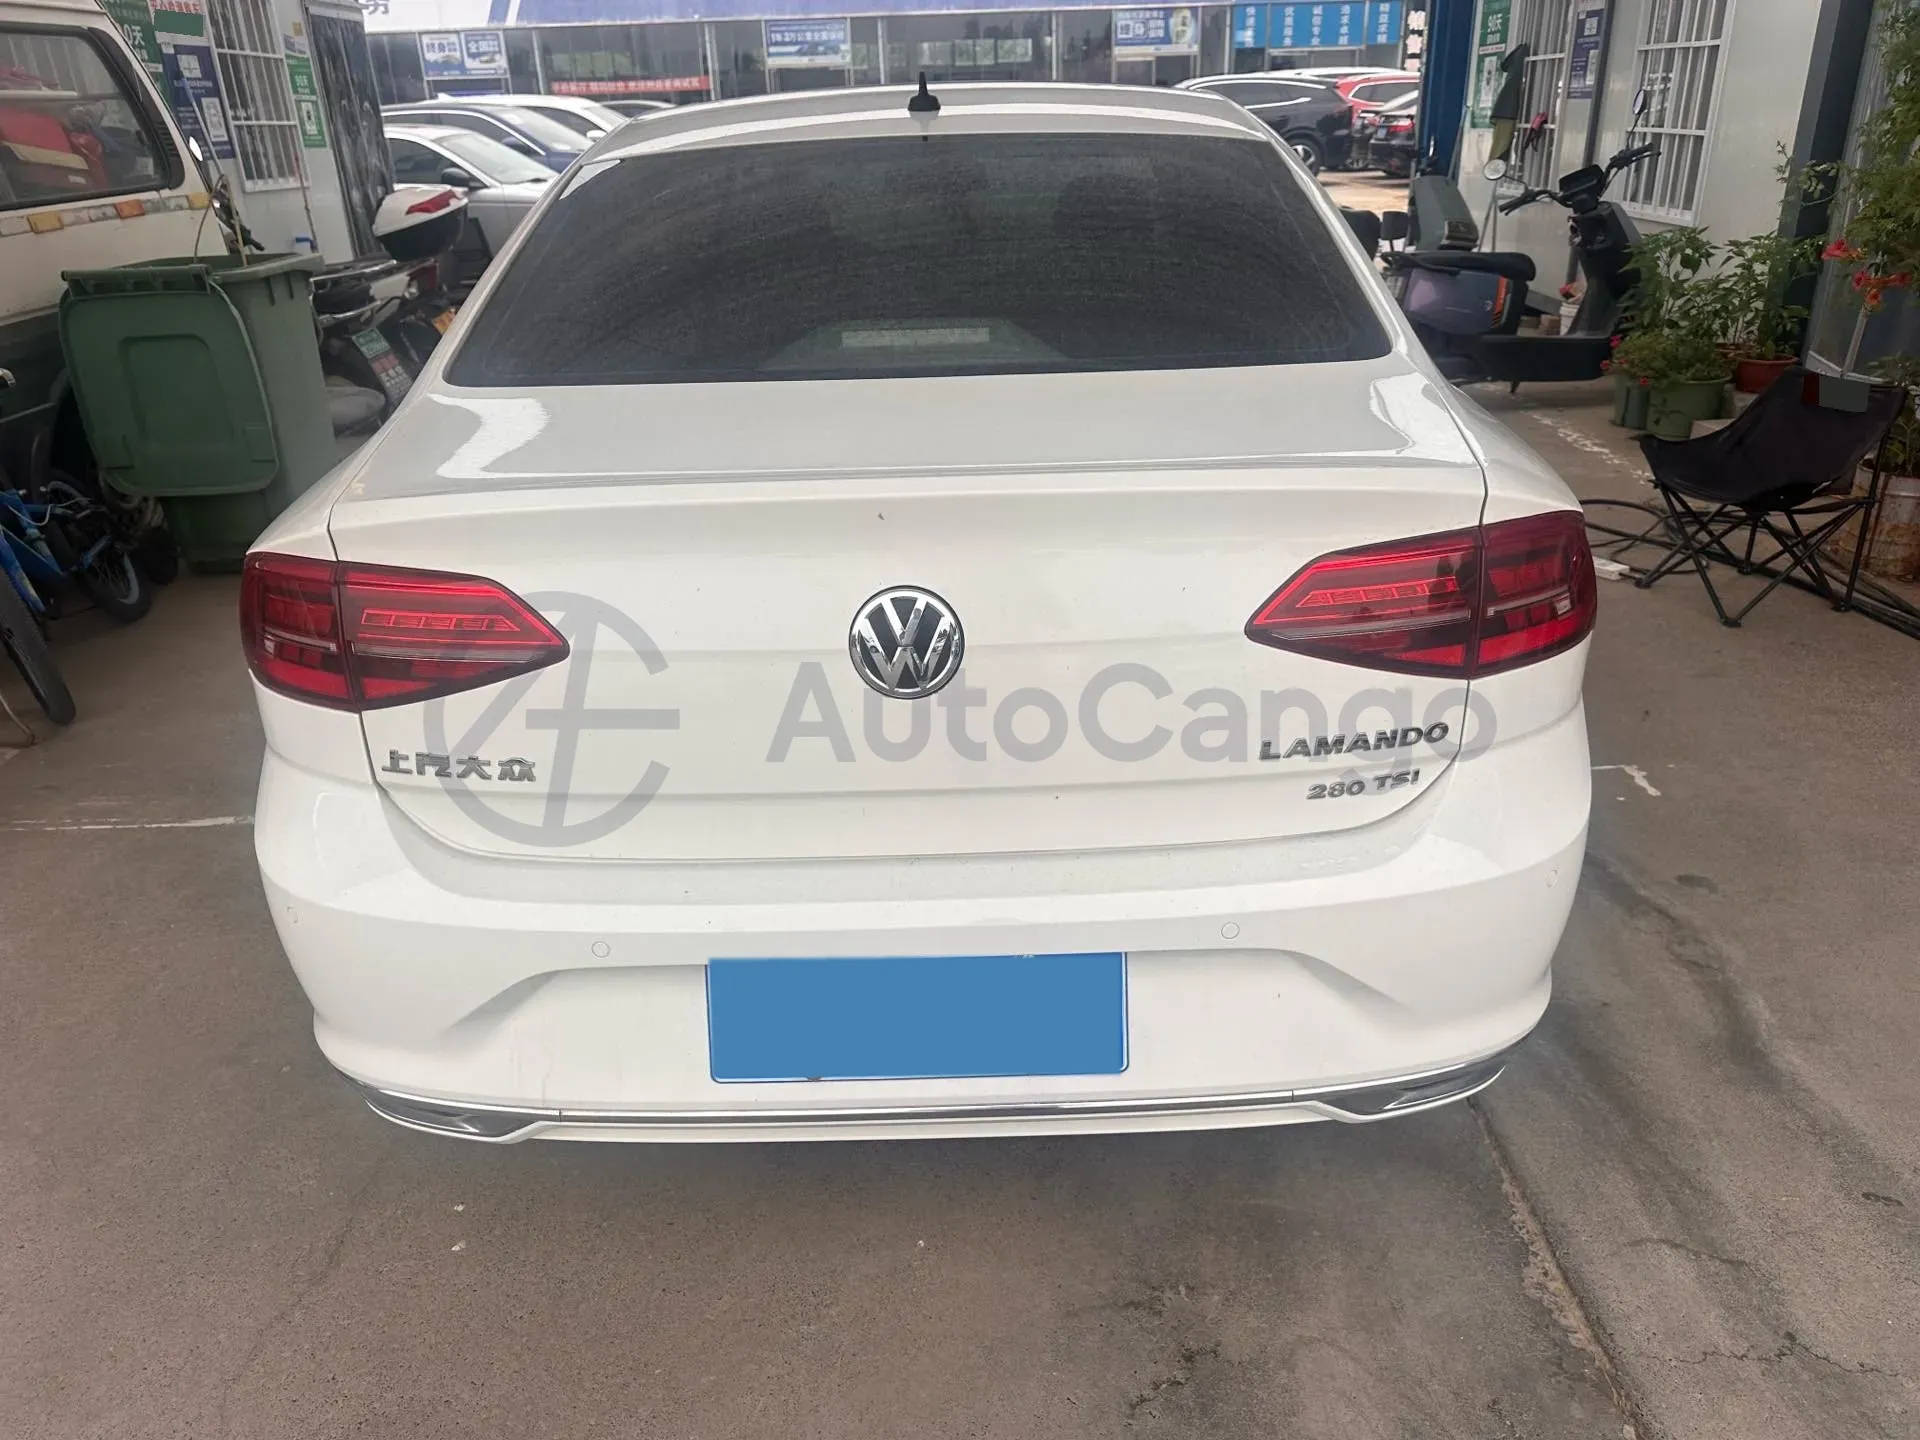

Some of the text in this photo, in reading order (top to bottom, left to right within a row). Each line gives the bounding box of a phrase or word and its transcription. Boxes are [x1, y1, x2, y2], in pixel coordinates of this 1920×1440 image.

[1259, 721, 1449, 760] LAMANDO
[381, 749, 537, 782] 上汽大众
[1306, 768, 1421, 800] 280 TSI
